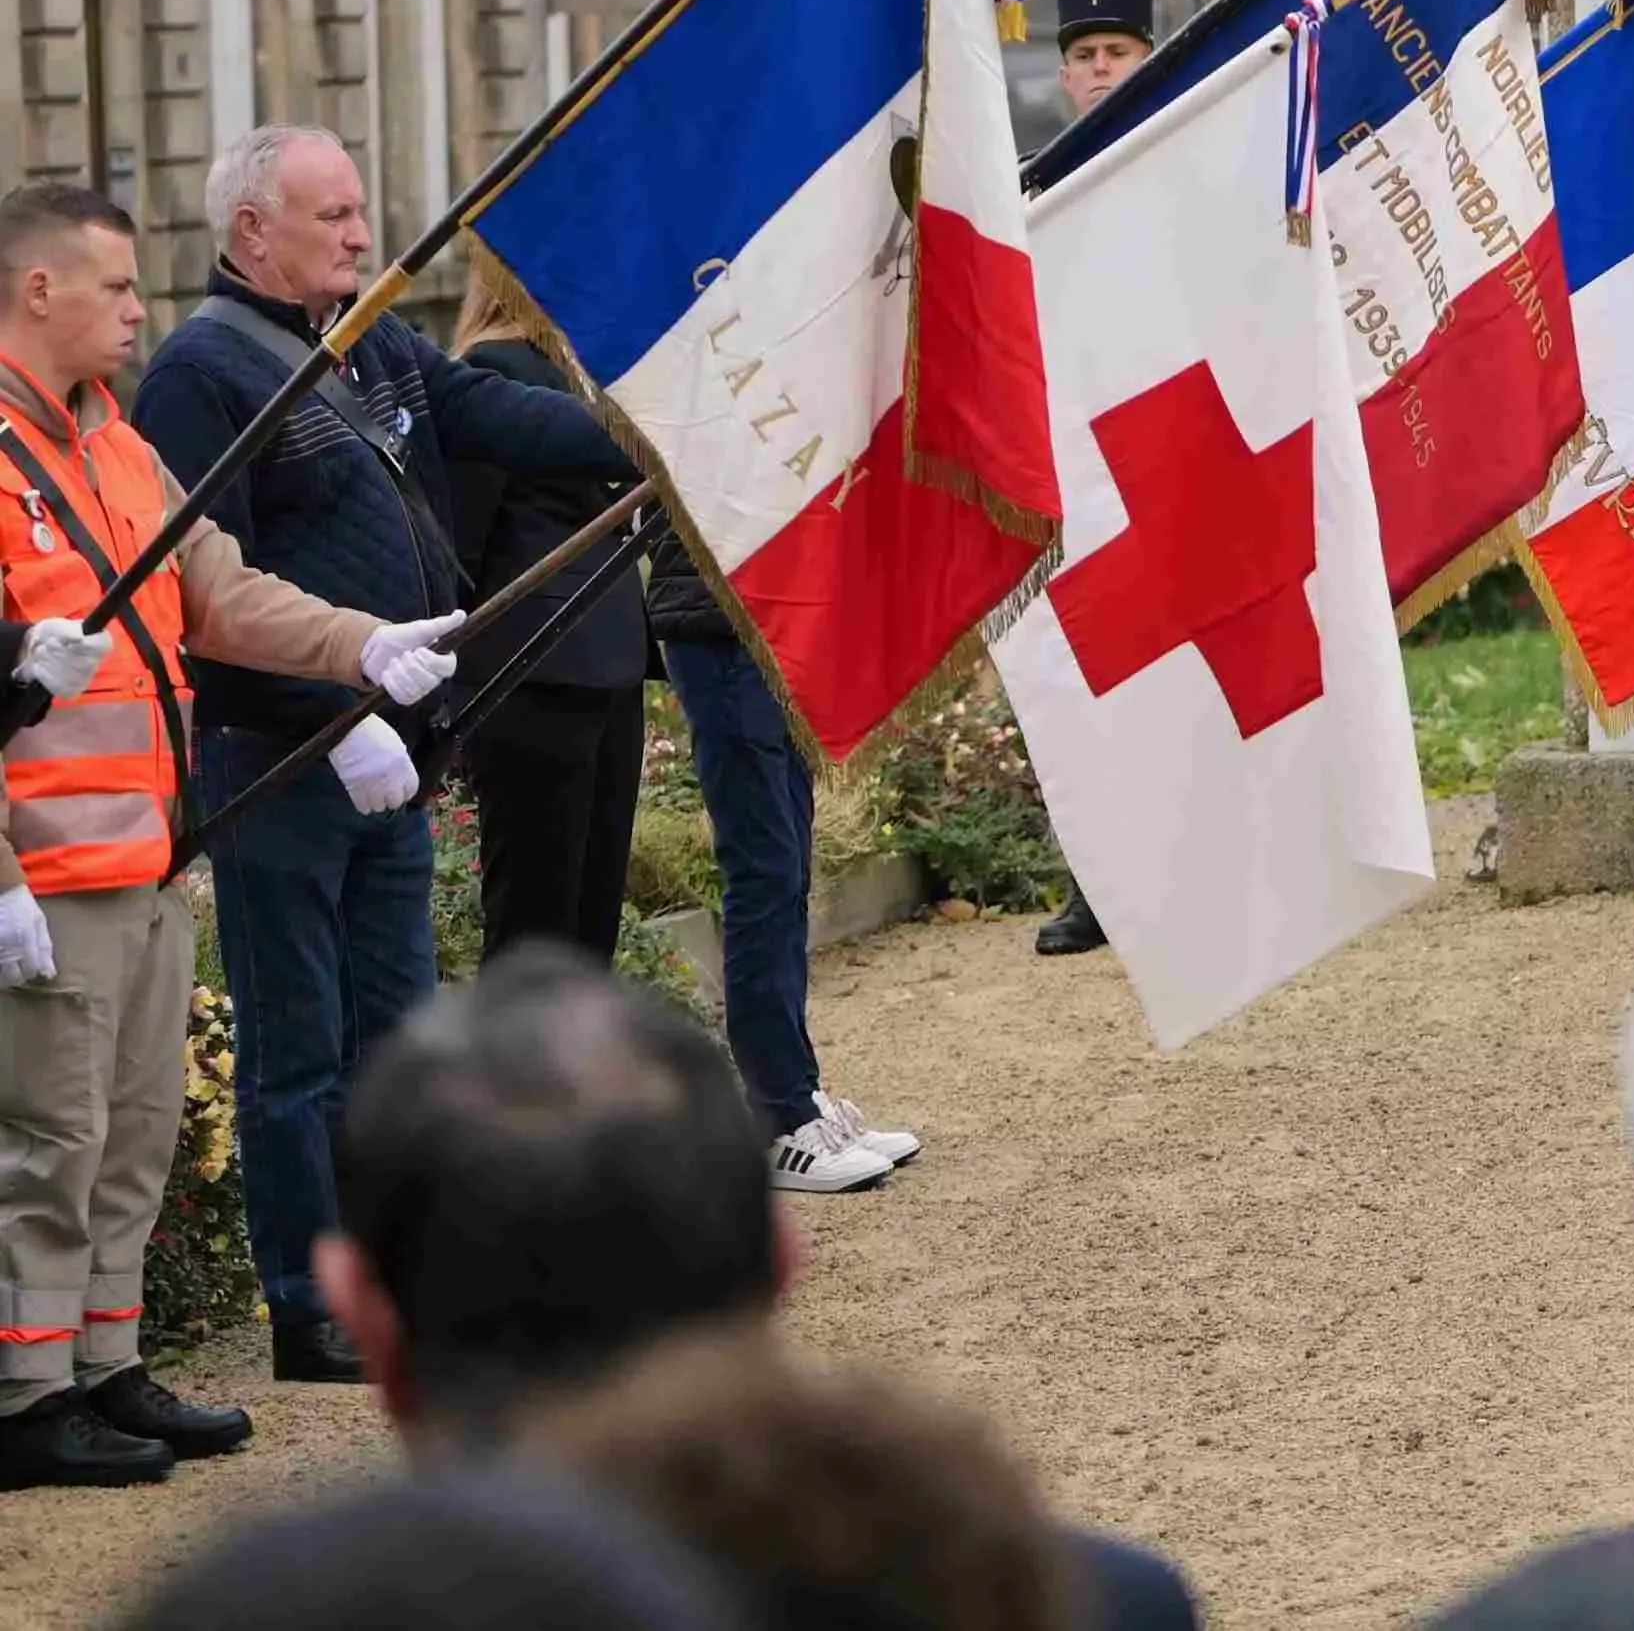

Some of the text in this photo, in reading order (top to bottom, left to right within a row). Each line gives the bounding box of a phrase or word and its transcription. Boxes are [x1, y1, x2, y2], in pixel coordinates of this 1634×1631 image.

[1339, 120, 1391, 172] ET
[1476, 34, 1551, 194] NOIRLIEU
[1445, 125, 1553, 361] COMBATTANTS
